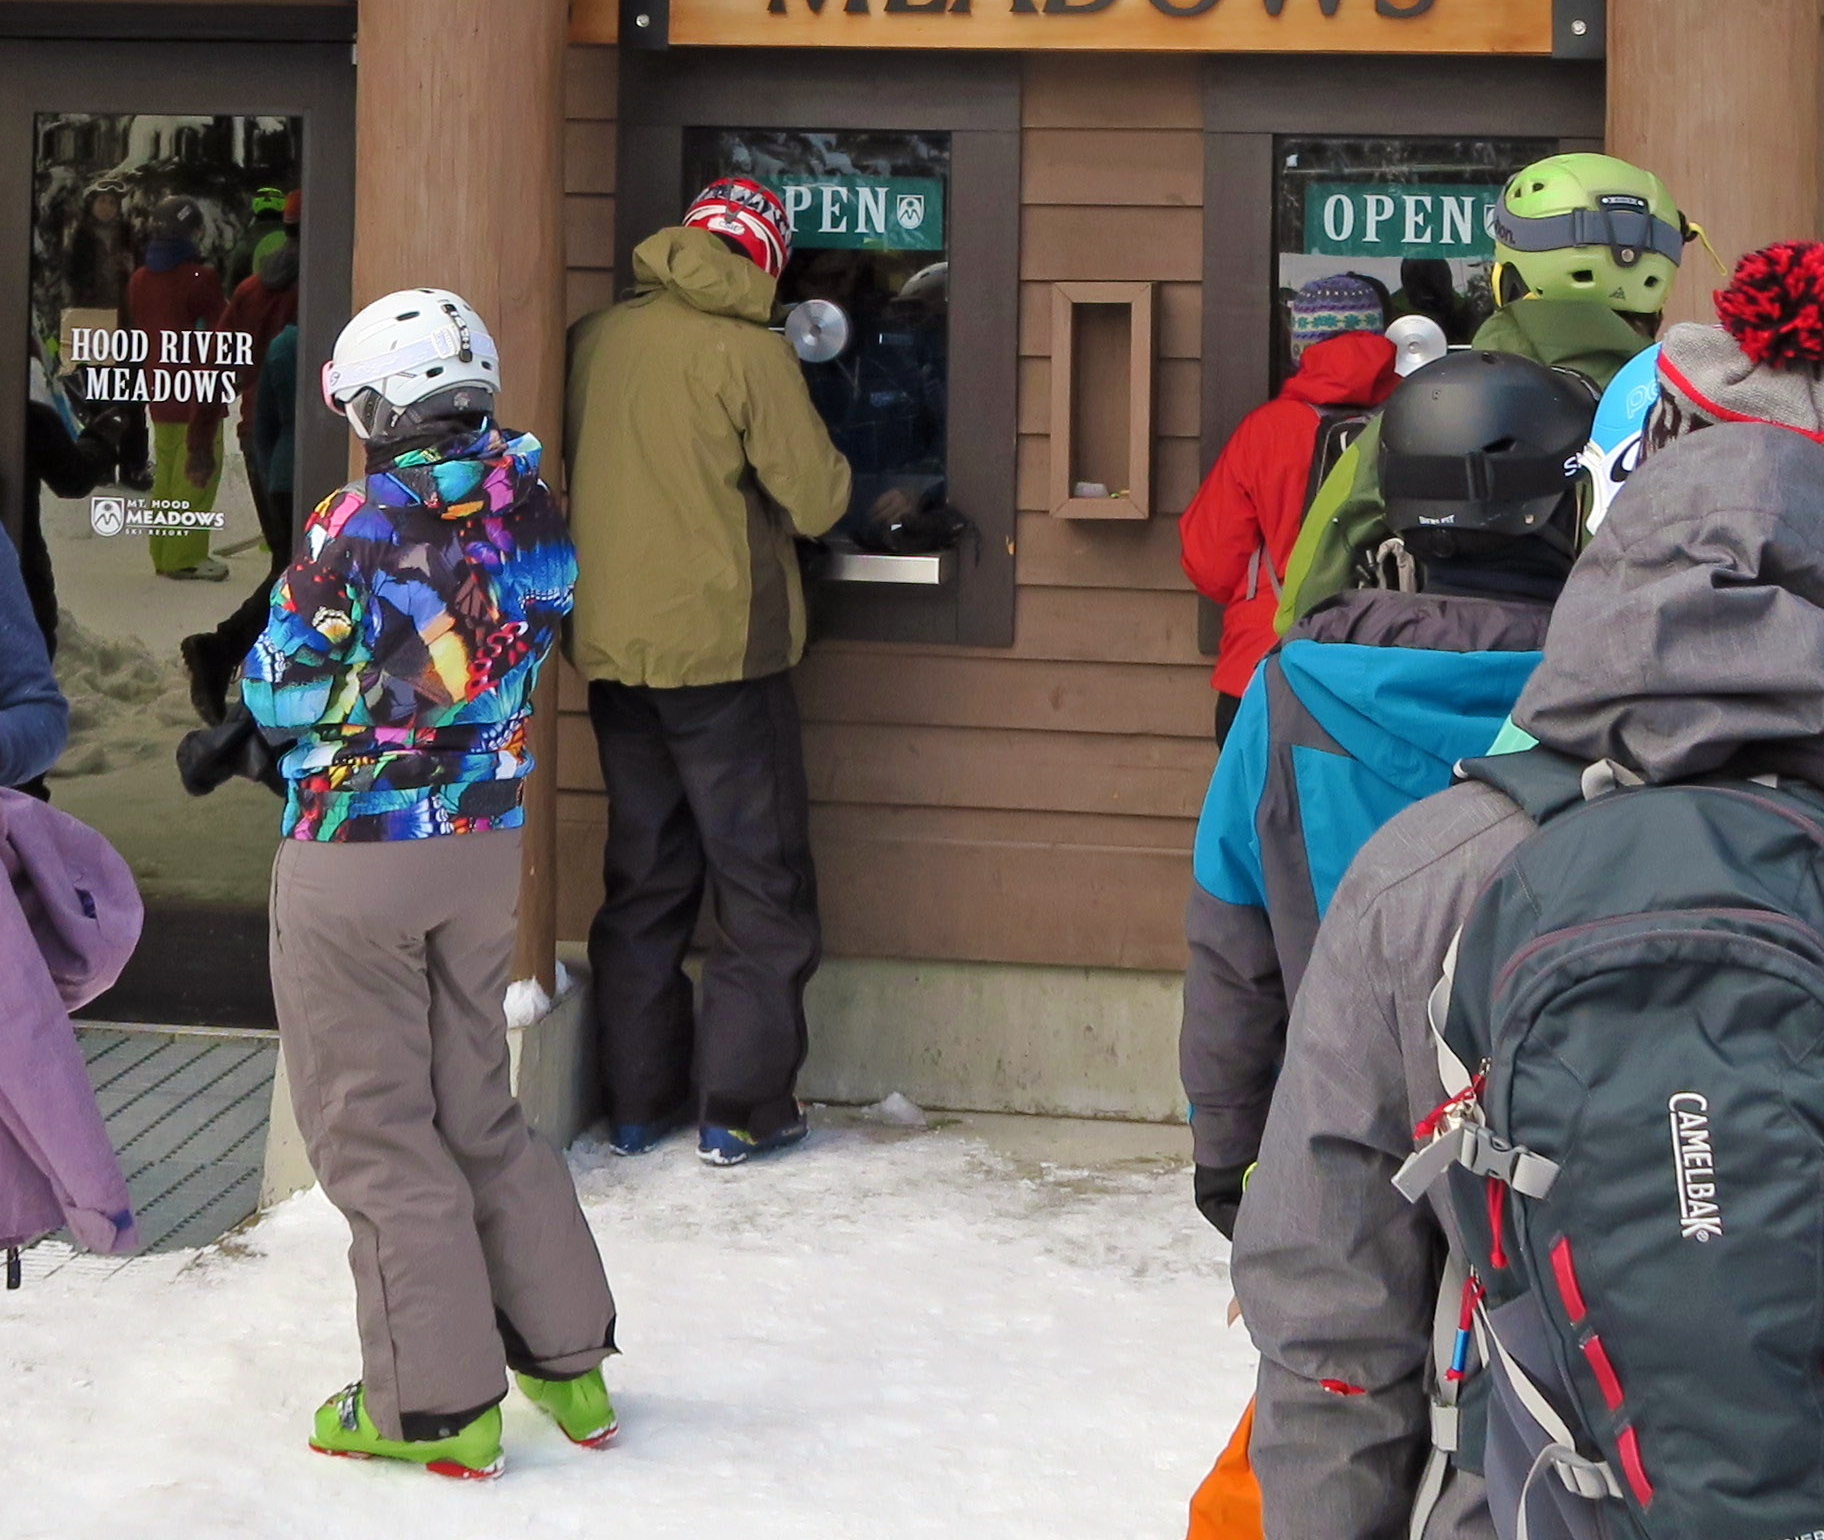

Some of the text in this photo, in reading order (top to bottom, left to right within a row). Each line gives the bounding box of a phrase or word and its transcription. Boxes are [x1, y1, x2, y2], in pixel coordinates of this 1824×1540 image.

[780, 184, 890, 234] PEN
[1322, 193, 1476, 245] OPEN
[69, 327, 255, 366] HOOD RIVER
[84, 367, 238, 405] MEADOWS
[125, 509, 226, 528] MEADOWS
[126, 498, 191, 510] MT. HOOD
[124, 528, 190, 537] SKI RESORT
